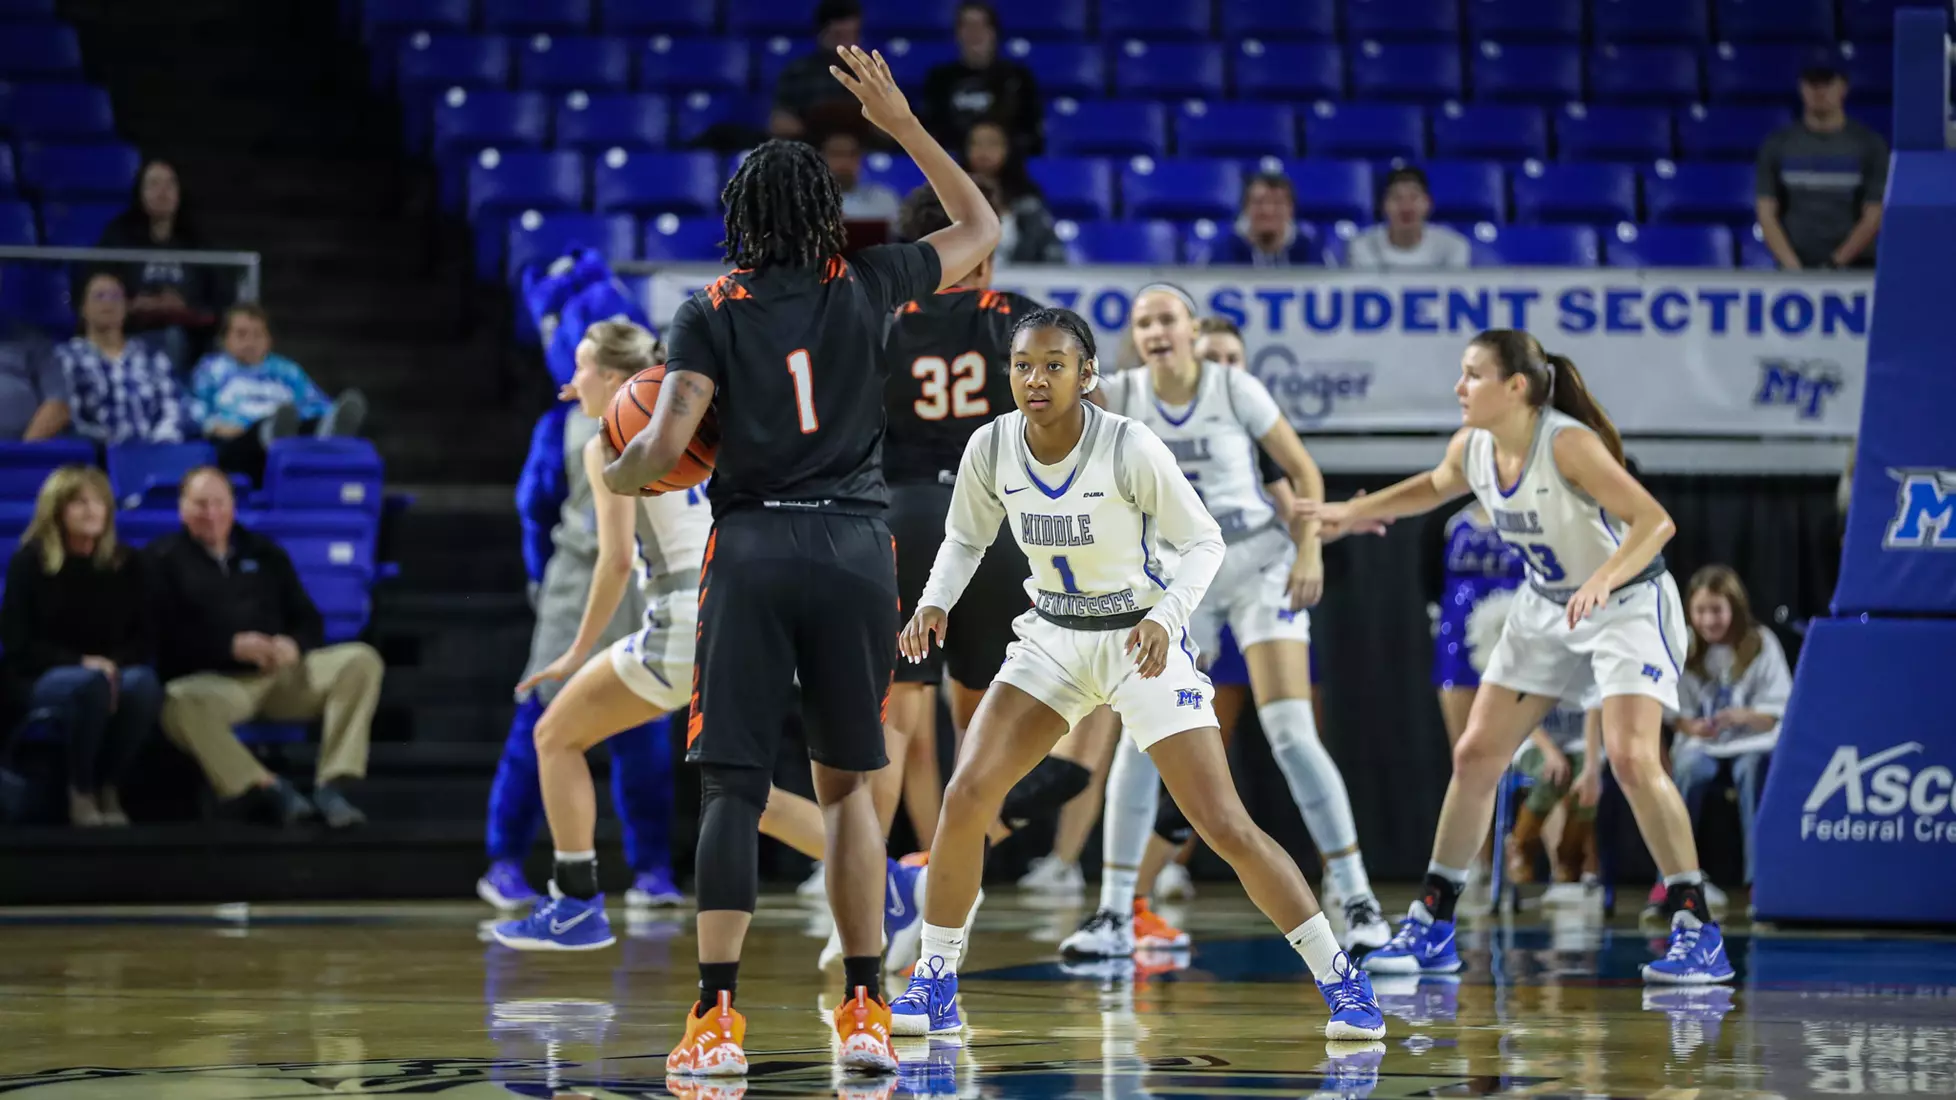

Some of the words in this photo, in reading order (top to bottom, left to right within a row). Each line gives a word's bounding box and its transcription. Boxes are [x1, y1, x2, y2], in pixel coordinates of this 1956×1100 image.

[1207, 286, 1541, 333] STUDENT
[1556, 286, 1868, 335] SECTION
[786, 348, 819, 434] 1
[911, 351, 990, 420] 32
[1755, 358, 1842, 420] MT
[1020, 512, 1095, 547] MIDDLE
[1051, 555, 1082, 594] 1
[1036, 587, 1140, 617] TENNESSEE
[1174, 688, 1204, 710] MT
[1802, 741, 1956, 817] Asc
[1801, 814, 1905, 842] Federal
